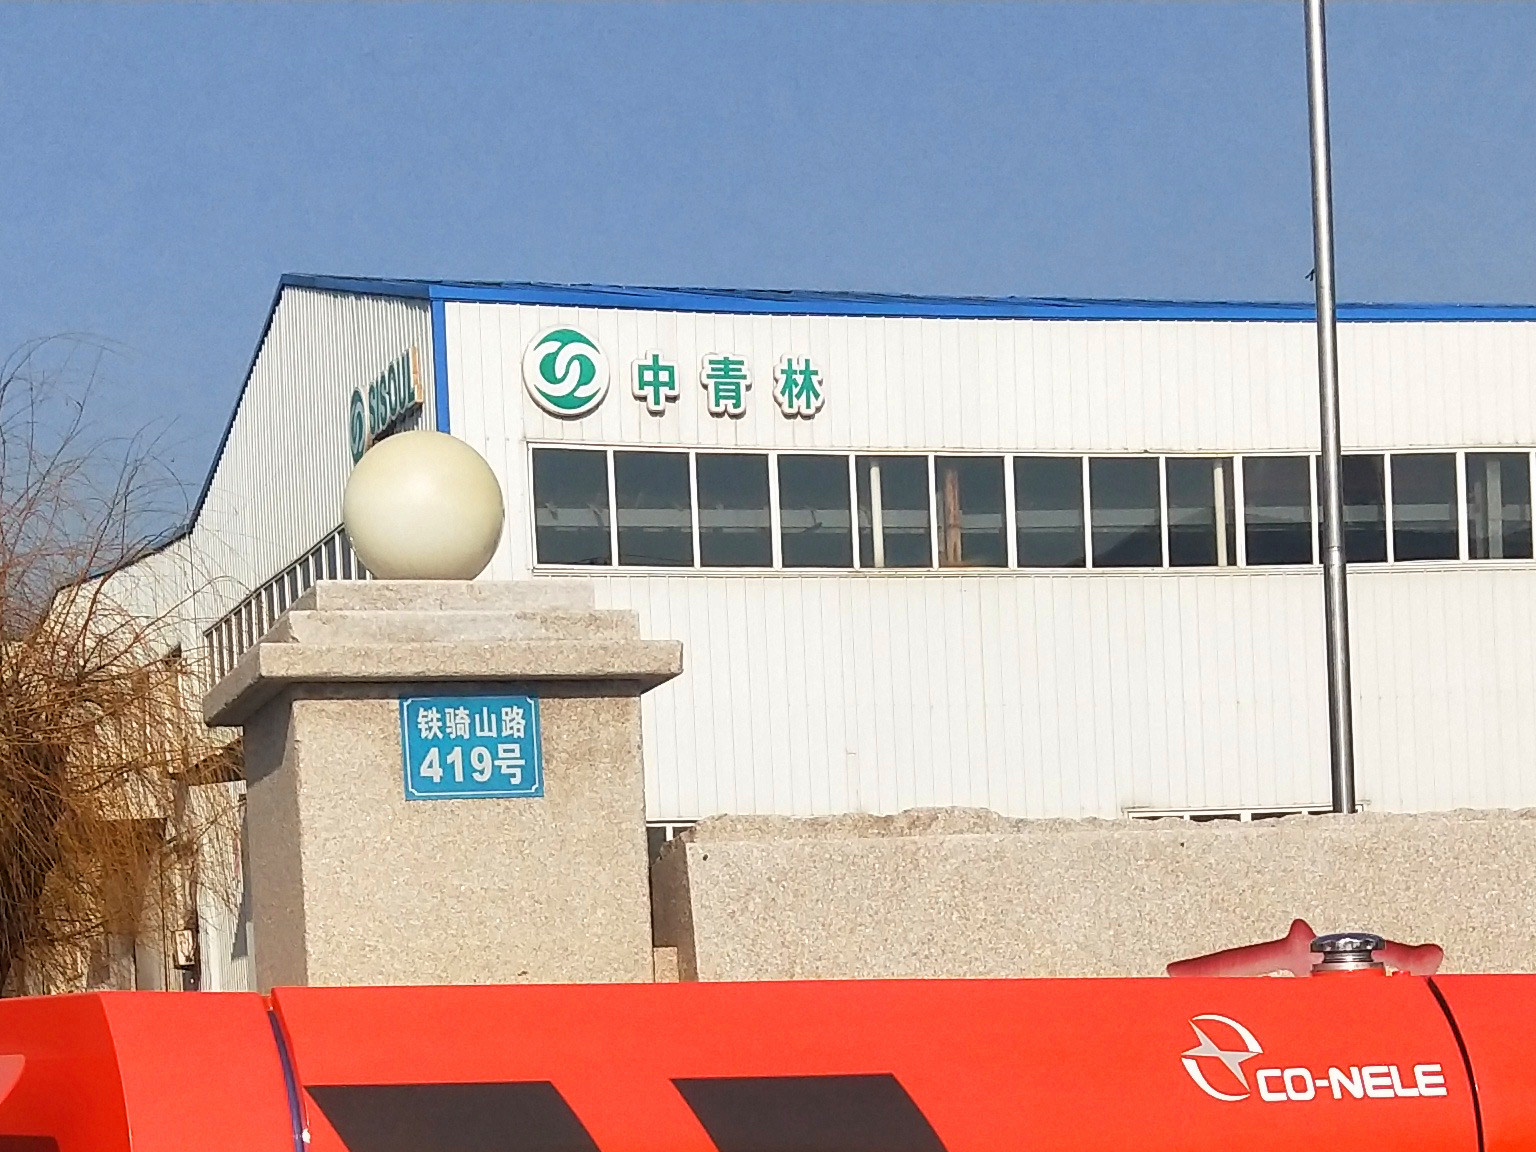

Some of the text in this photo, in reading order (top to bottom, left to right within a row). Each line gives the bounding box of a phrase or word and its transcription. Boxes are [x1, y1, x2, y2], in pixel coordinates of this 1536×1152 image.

[368, 350, 416, 435] SISOUL
[637, 353, 821, 410] 中青林
[417, 705, 526, 739] 铁骑山路
[420, 743, 526, 785] 419号
[1255, 1063, 1448, 1102] CO-NELE
